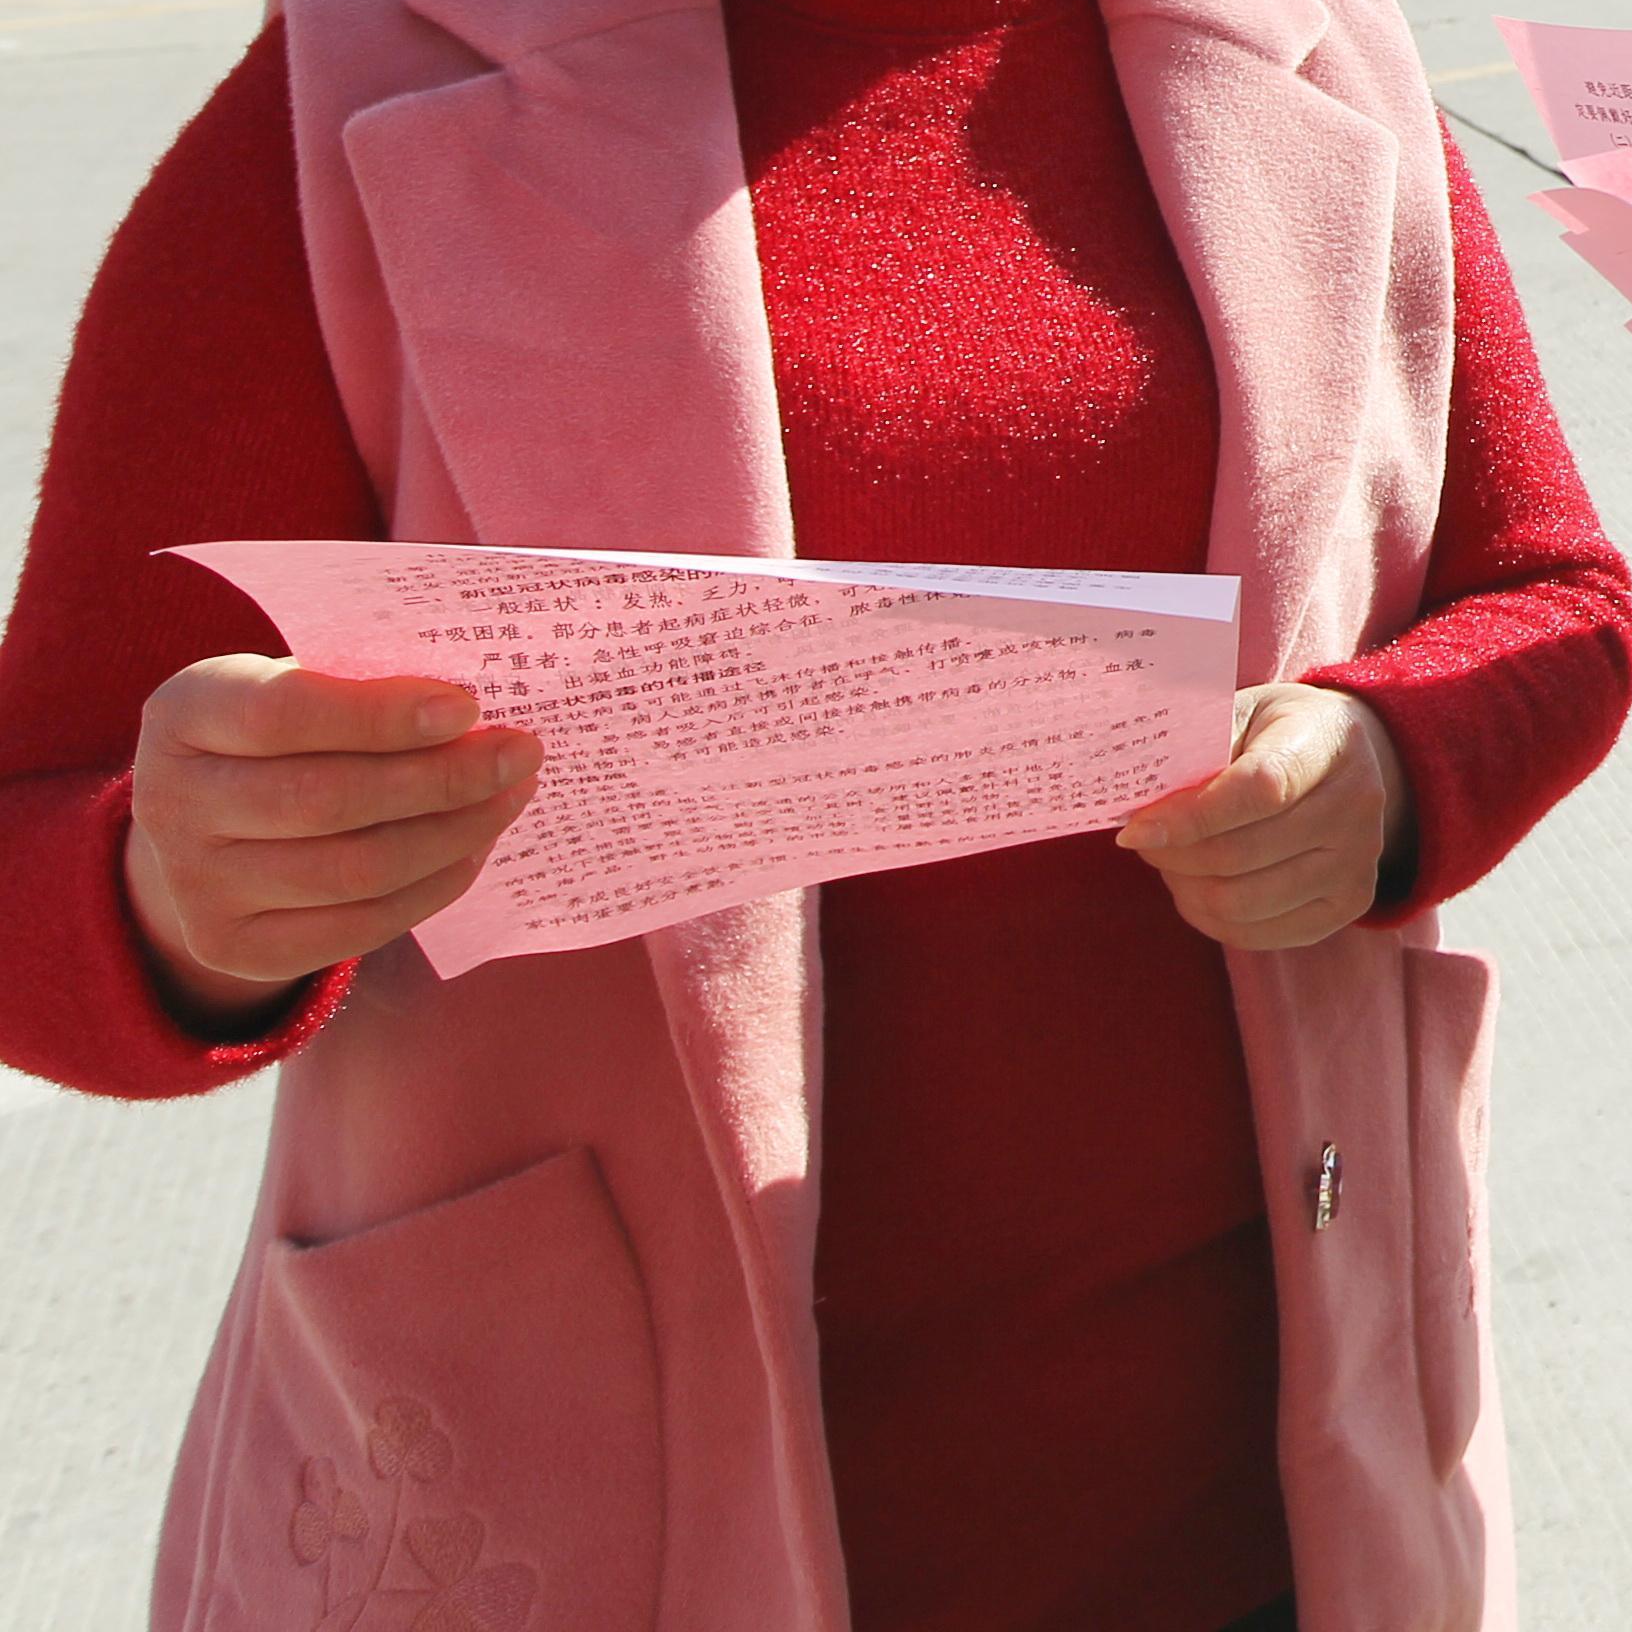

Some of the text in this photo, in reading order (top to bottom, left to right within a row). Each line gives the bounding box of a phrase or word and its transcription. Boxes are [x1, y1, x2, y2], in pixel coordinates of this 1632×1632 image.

[402, 567, 728, 606] 二、新型冠状病毒感染的
